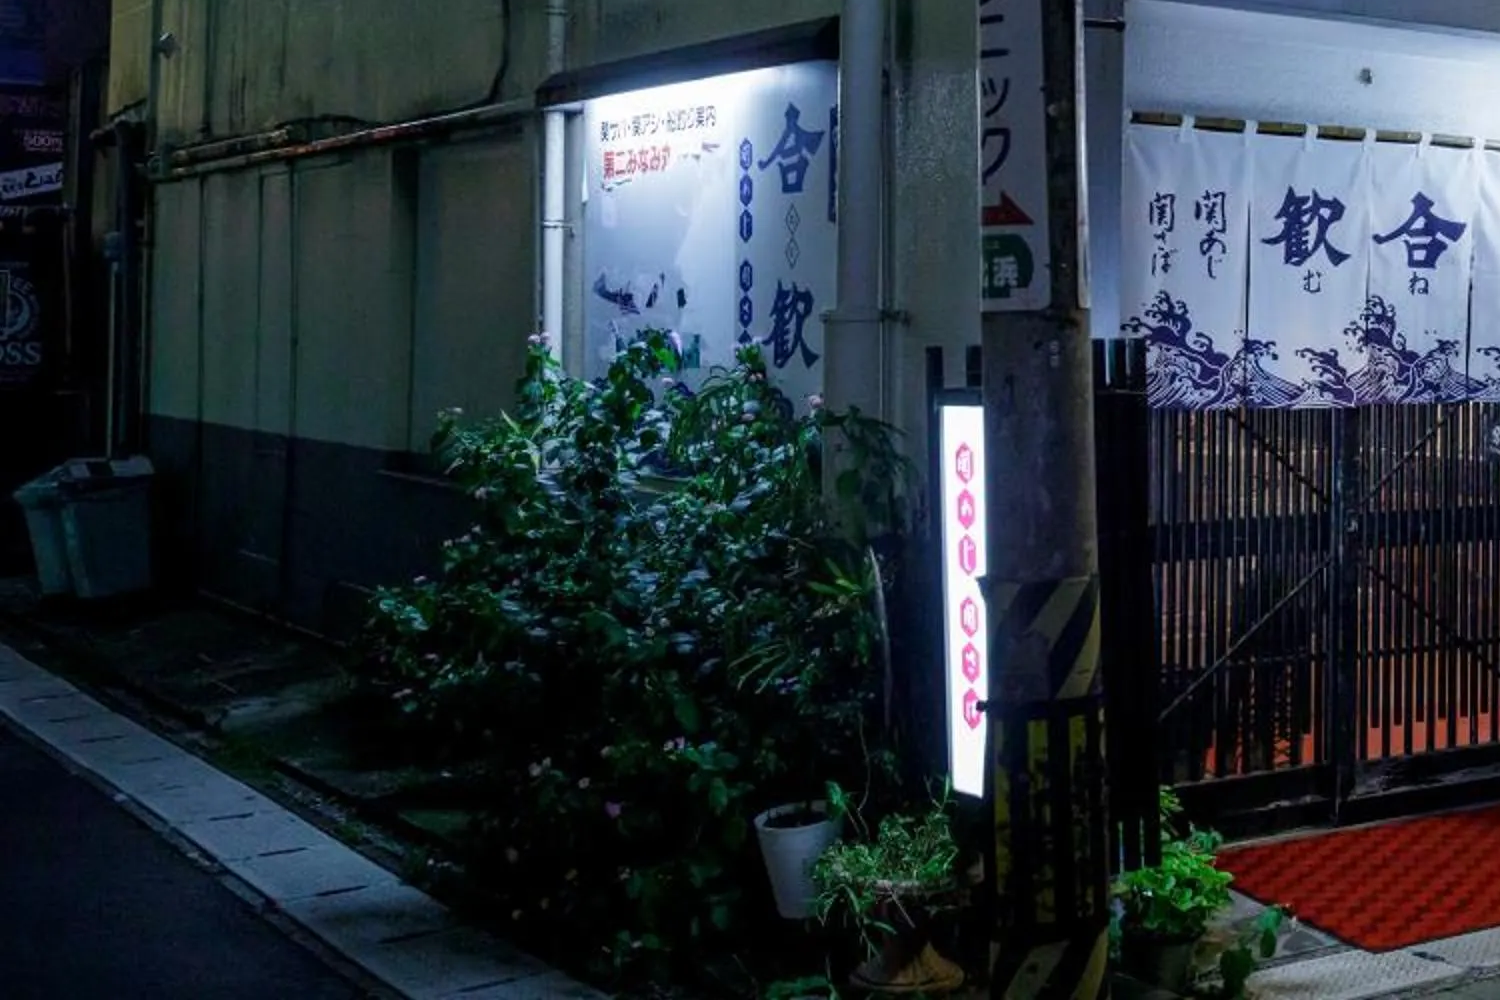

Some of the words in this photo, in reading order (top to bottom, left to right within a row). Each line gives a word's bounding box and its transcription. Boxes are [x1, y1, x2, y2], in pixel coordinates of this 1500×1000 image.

[758, 102, 825, 194] 合
[1149, 192, 1175, 277] 関さば
[1195, 190, 1227, 279] 関あじ
[1261, 185, 1351, 267] 歓
[1373, 191, 1466, 269] 合
[1303, 270, 1321, 293] む
[1410, 271, 1429, 297] ね
[761, 280, 819, 370] 歓
